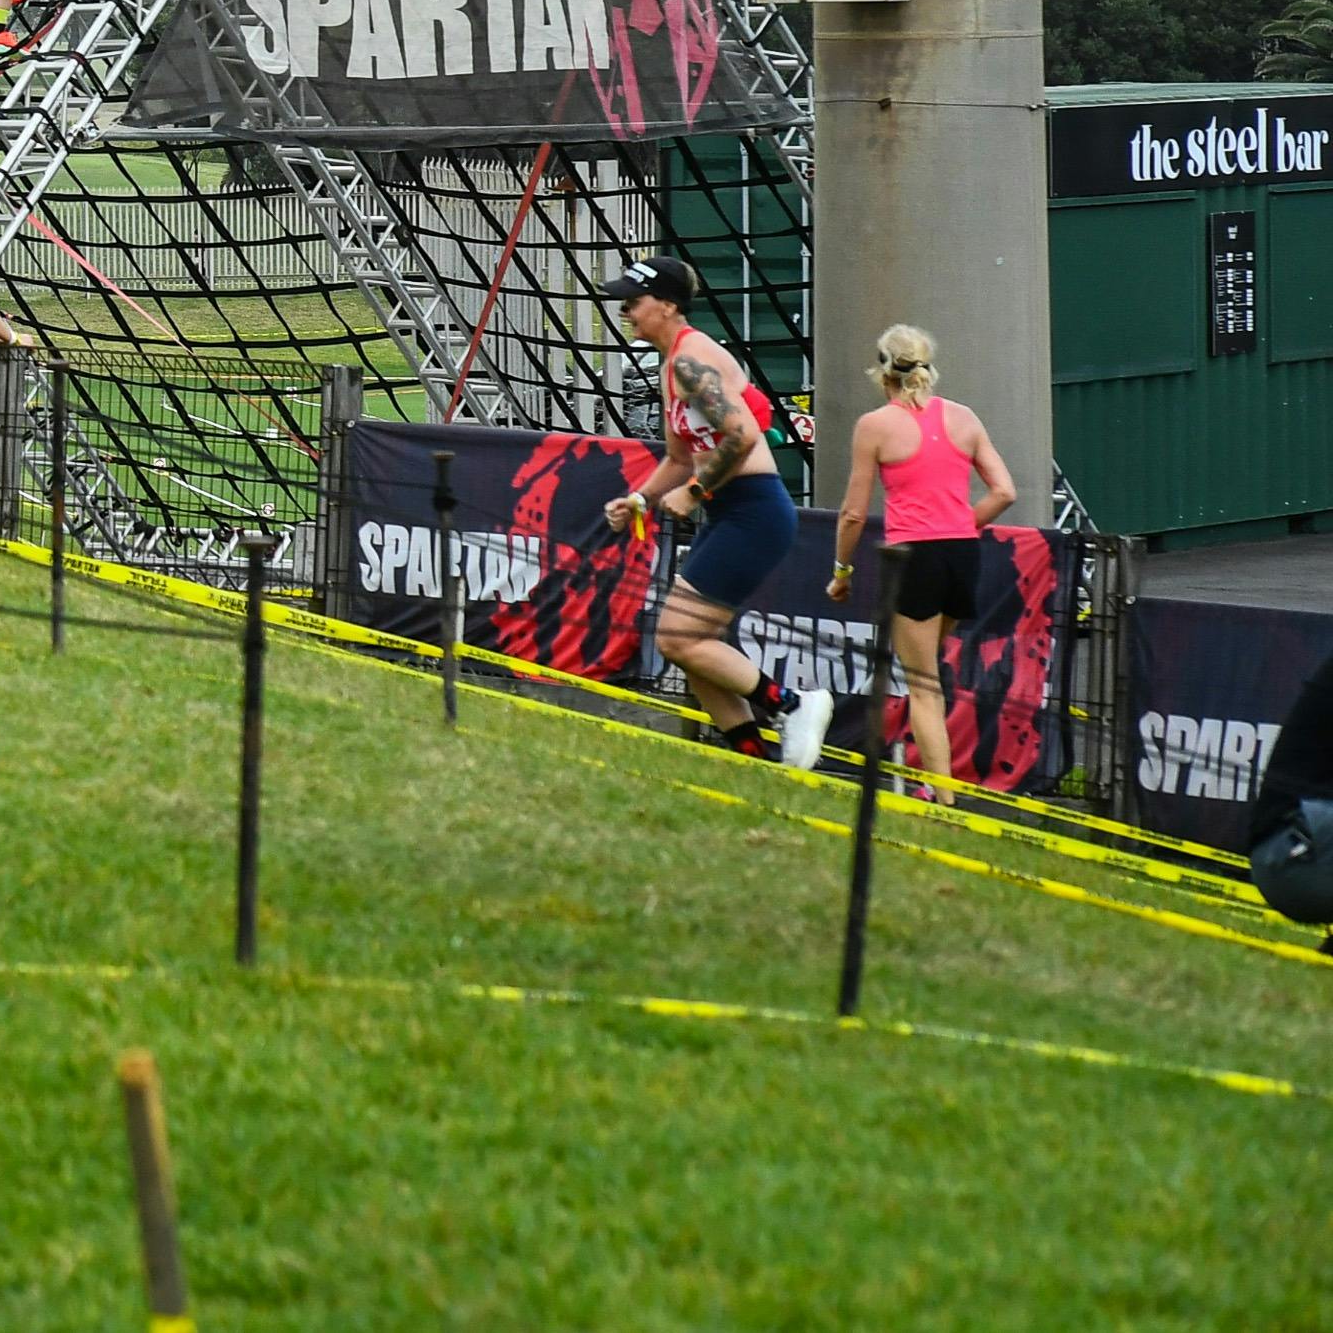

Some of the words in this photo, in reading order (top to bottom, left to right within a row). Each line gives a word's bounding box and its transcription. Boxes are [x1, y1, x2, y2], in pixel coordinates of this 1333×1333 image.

[1130, 124, 1181, 182] the
[1186, 107, 1269, 178] steel
[1275, 117, 1329, 173] bar
[358, 520, 541, 604] SPARTAN
[738, 609, 910, 697] SPART
[1138, 710, 1284, 803] SPART
